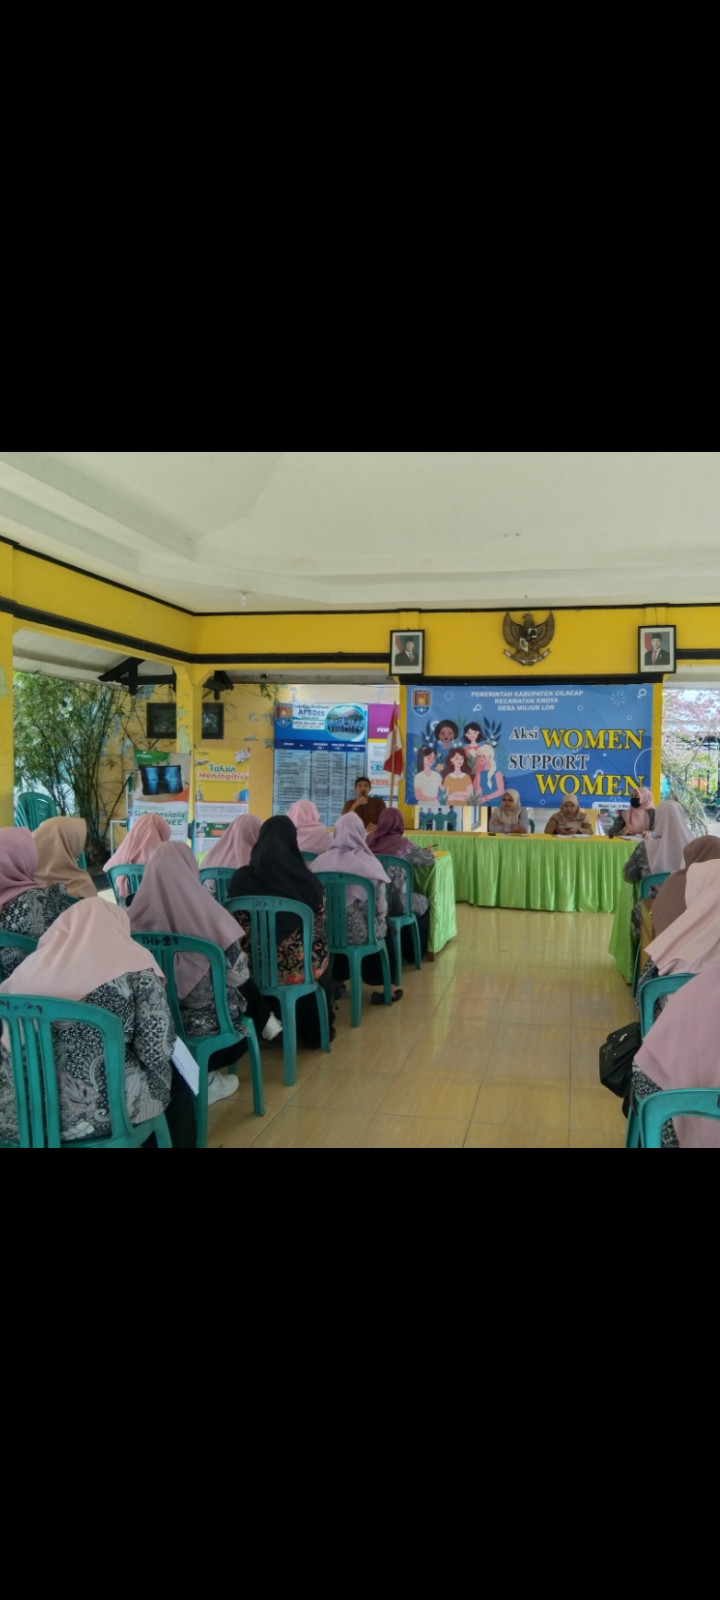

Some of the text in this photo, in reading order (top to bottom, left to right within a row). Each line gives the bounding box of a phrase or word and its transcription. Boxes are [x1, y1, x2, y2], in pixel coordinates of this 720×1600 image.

[509, 726, 645, 750] Aksi WOMEN
[208, 763, 236, 773] Vaksin
[508, 754, 589, 771] SUPPORT
[198, 772, 245, 782] Meningitis
[535, 773, 645, 797] WOMEN
